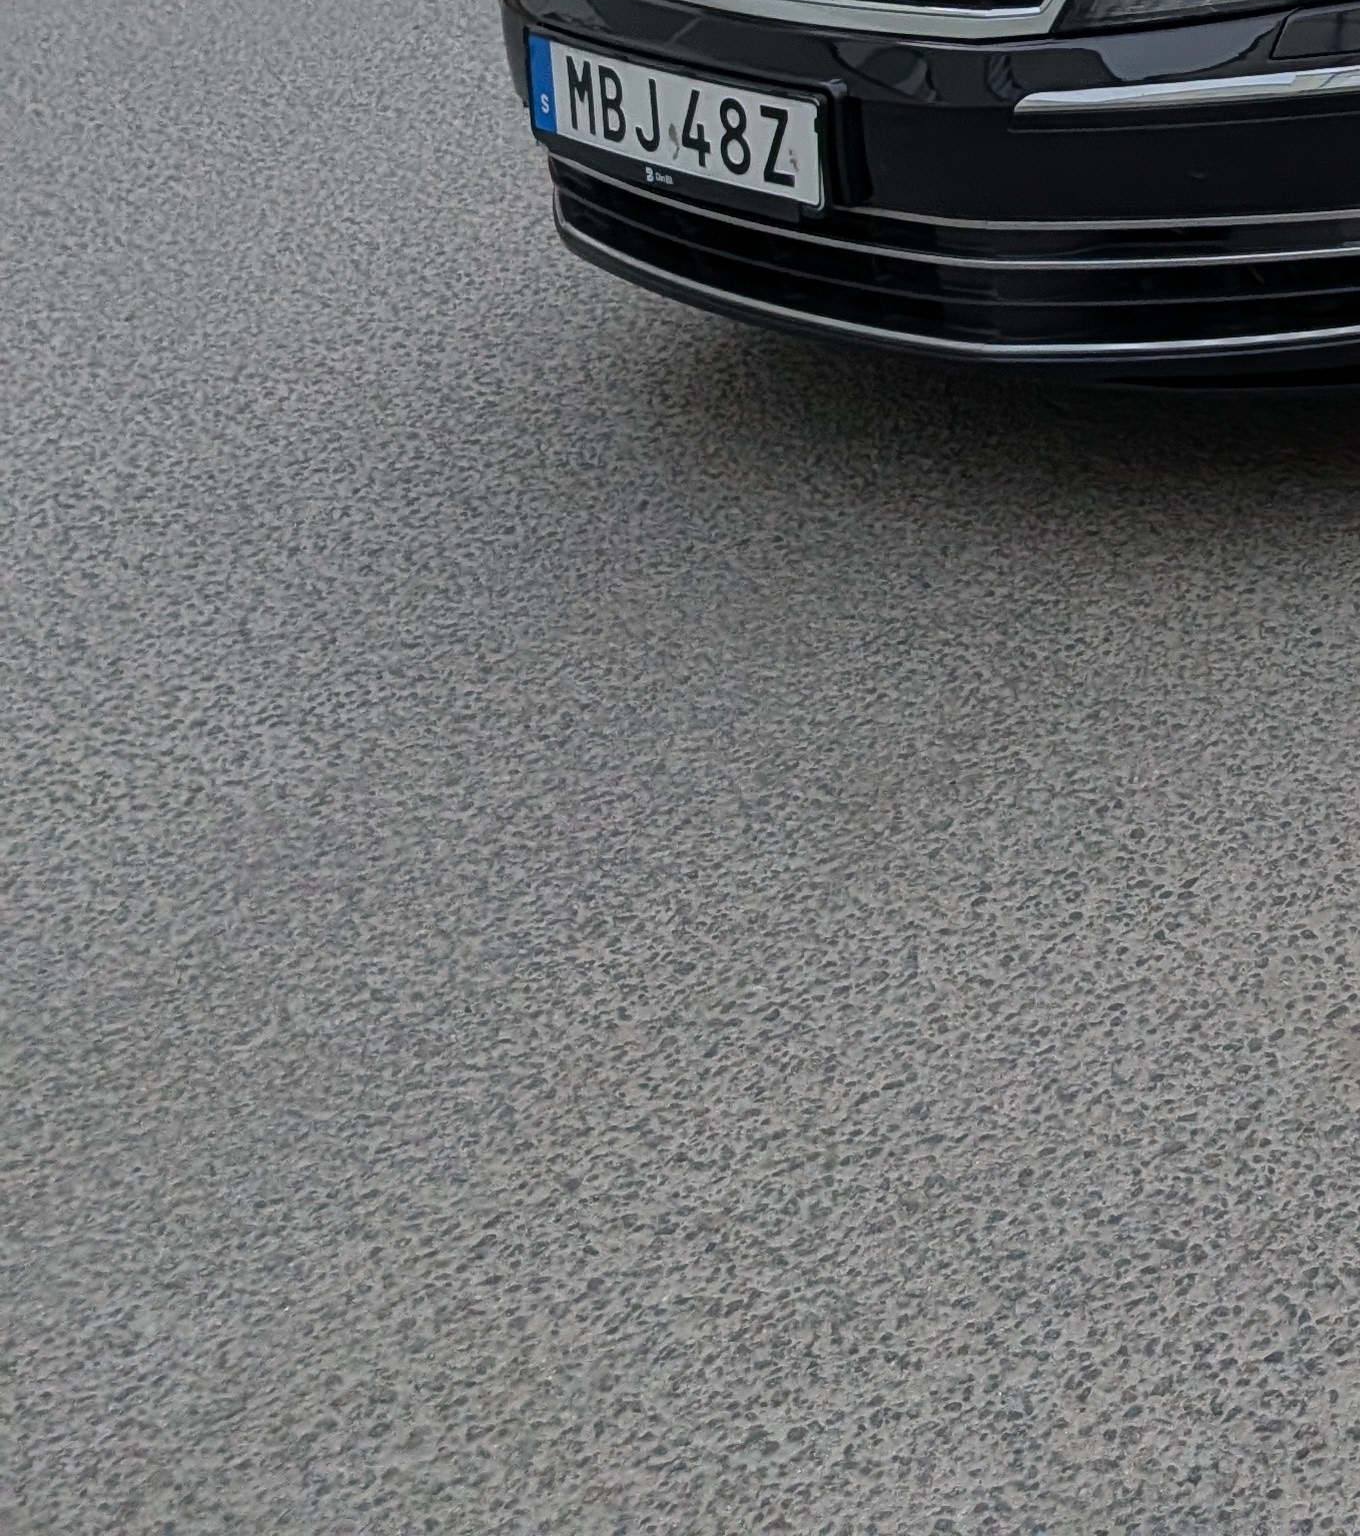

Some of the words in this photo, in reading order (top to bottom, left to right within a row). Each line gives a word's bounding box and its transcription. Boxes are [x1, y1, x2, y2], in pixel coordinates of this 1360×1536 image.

[540, 92, 551, 114] S
[566, 54, 661, 153] MBJ
[681, 88, 796, 188] 48Z
